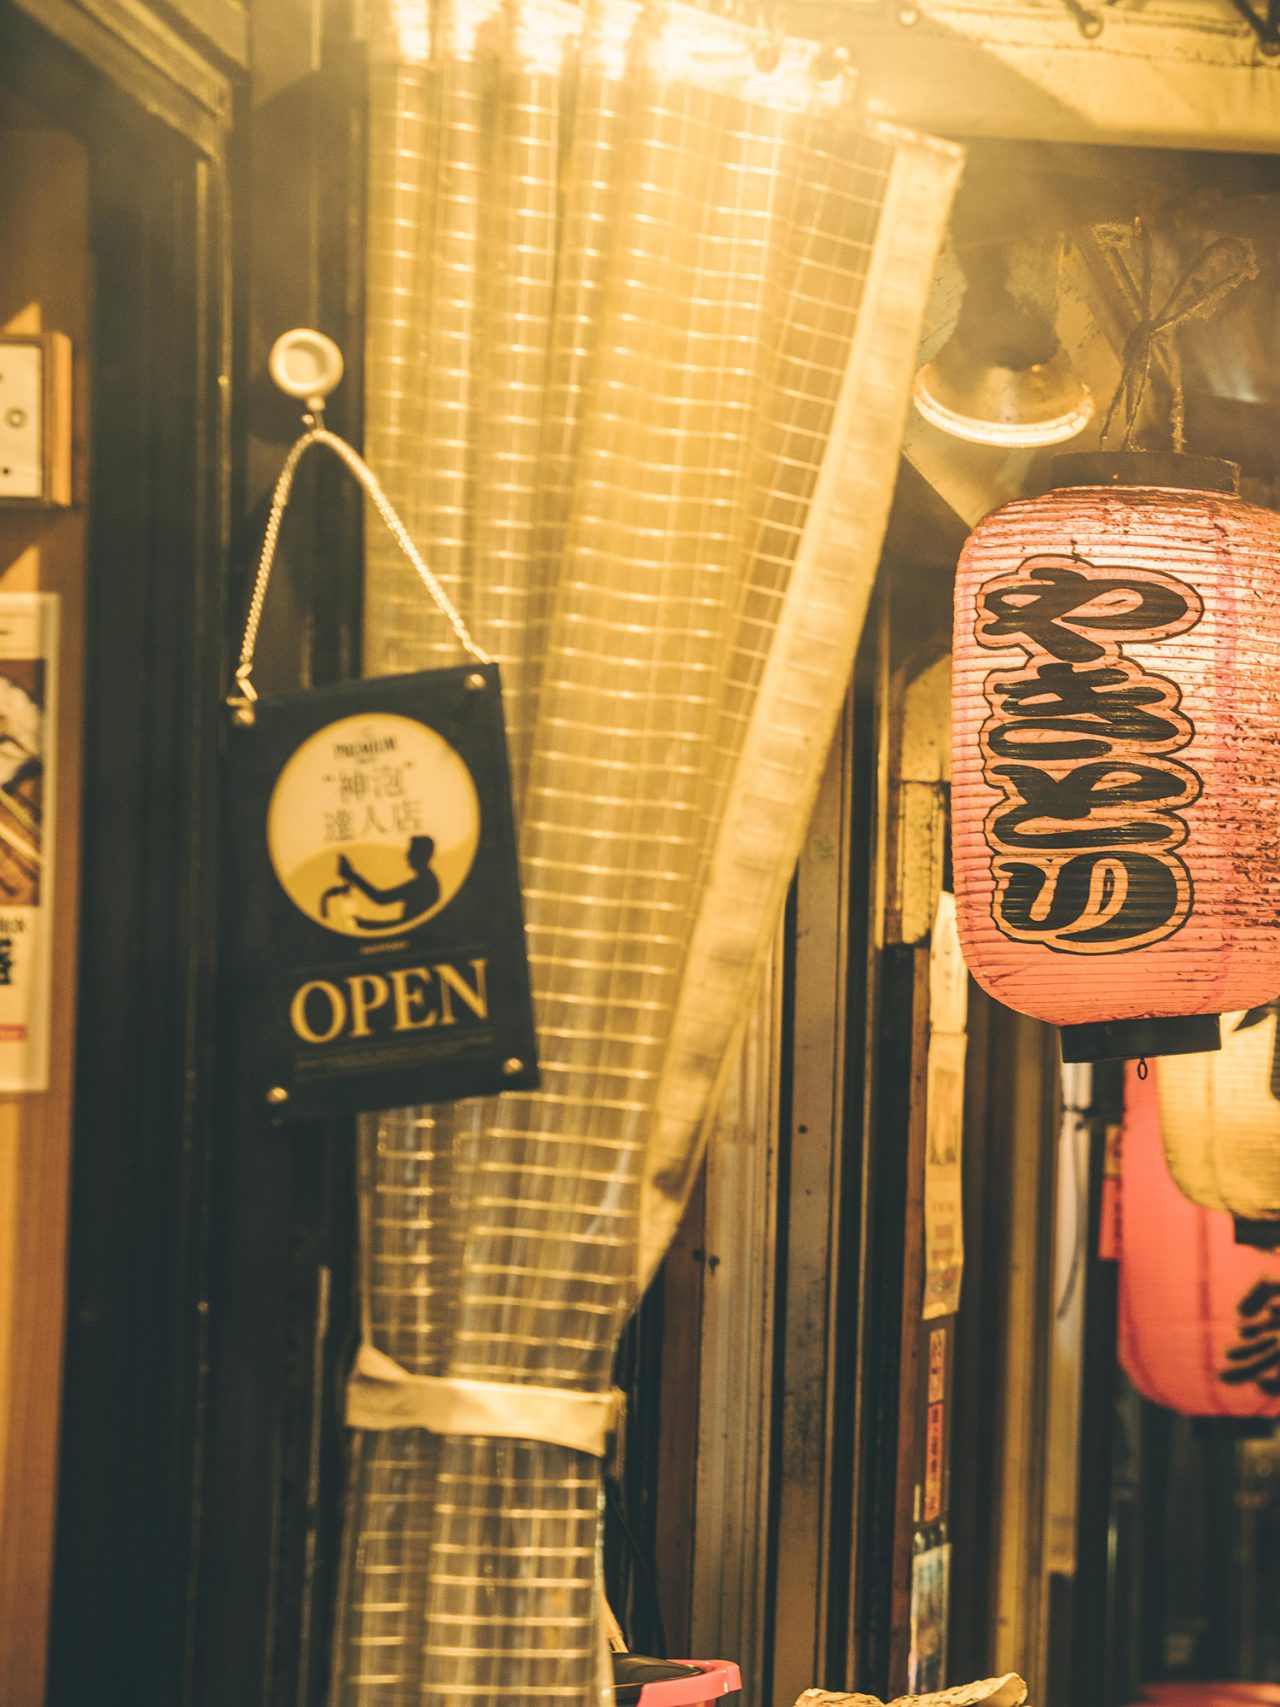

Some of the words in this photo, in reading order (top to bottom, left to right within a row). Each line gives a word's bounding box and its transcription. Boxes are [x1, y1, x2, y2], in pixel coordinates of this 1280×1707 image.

[981, 566, 1190, 944] やきとり
[322, 800, 423, 841] 達人店
[290, 958, 489, 1045] OPEN
